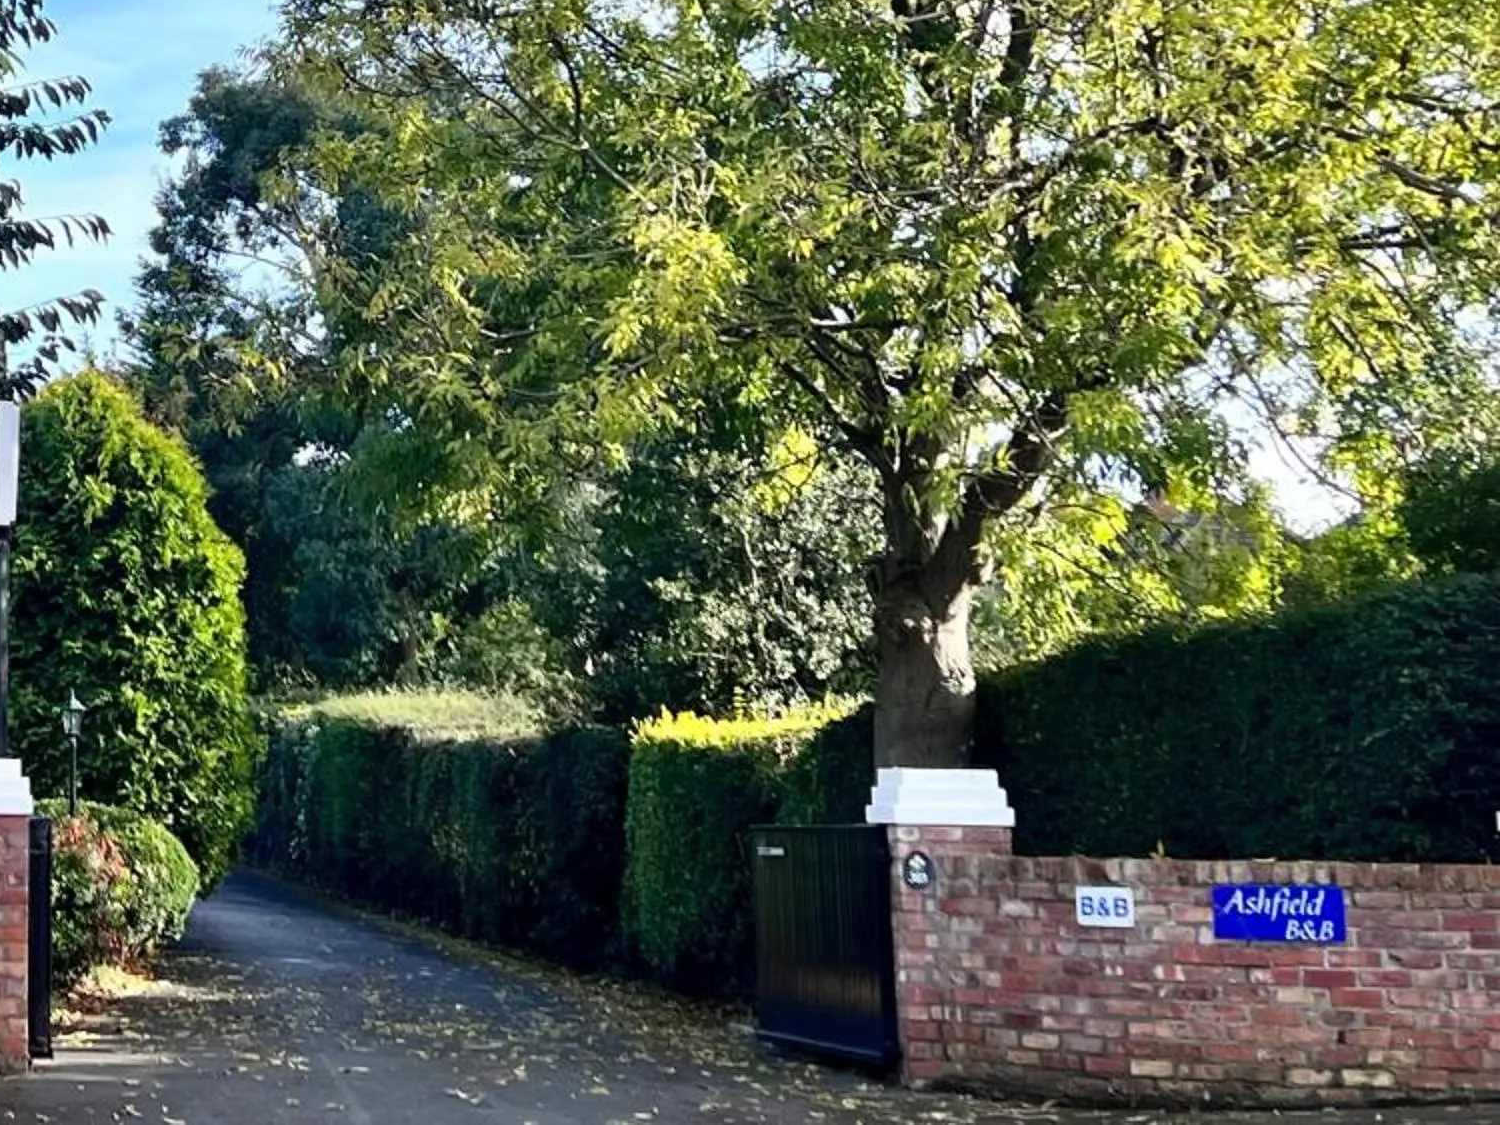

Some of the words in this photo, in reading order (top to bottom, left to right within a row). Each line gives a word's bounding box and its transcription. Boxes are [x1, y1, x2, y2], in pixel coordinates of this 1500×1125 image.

[1080, 895, 1130, 918] B&B
[1223, 887, 1326, 922] Ashfield
[1285, 919, 1336, 941] B&B
